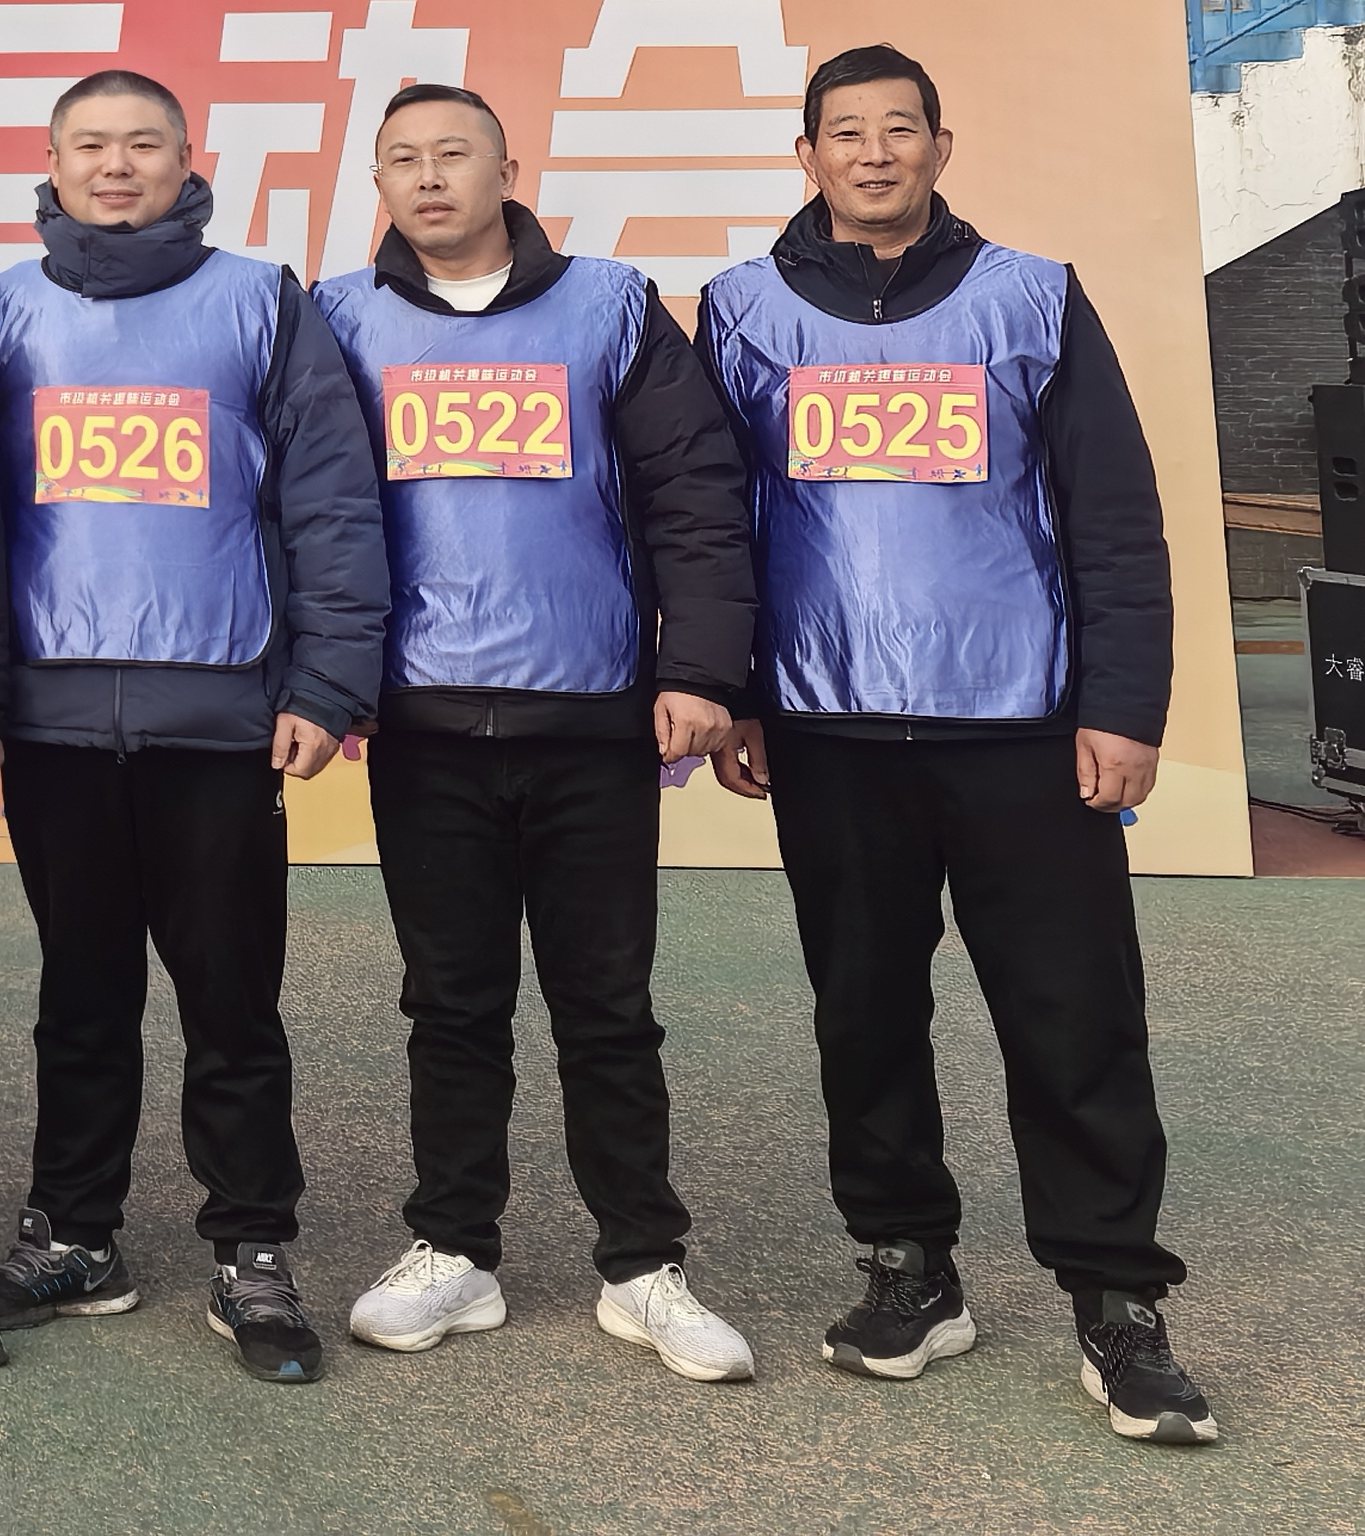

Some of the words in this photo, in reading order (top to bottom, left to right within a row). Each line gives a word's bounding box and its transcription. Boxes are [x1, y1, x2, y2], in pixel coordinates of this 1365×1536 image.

[40, 414, 204, 483] 0526
[390, 390, 565, 457] 0522
[794, 391, 982, 460] 0525
